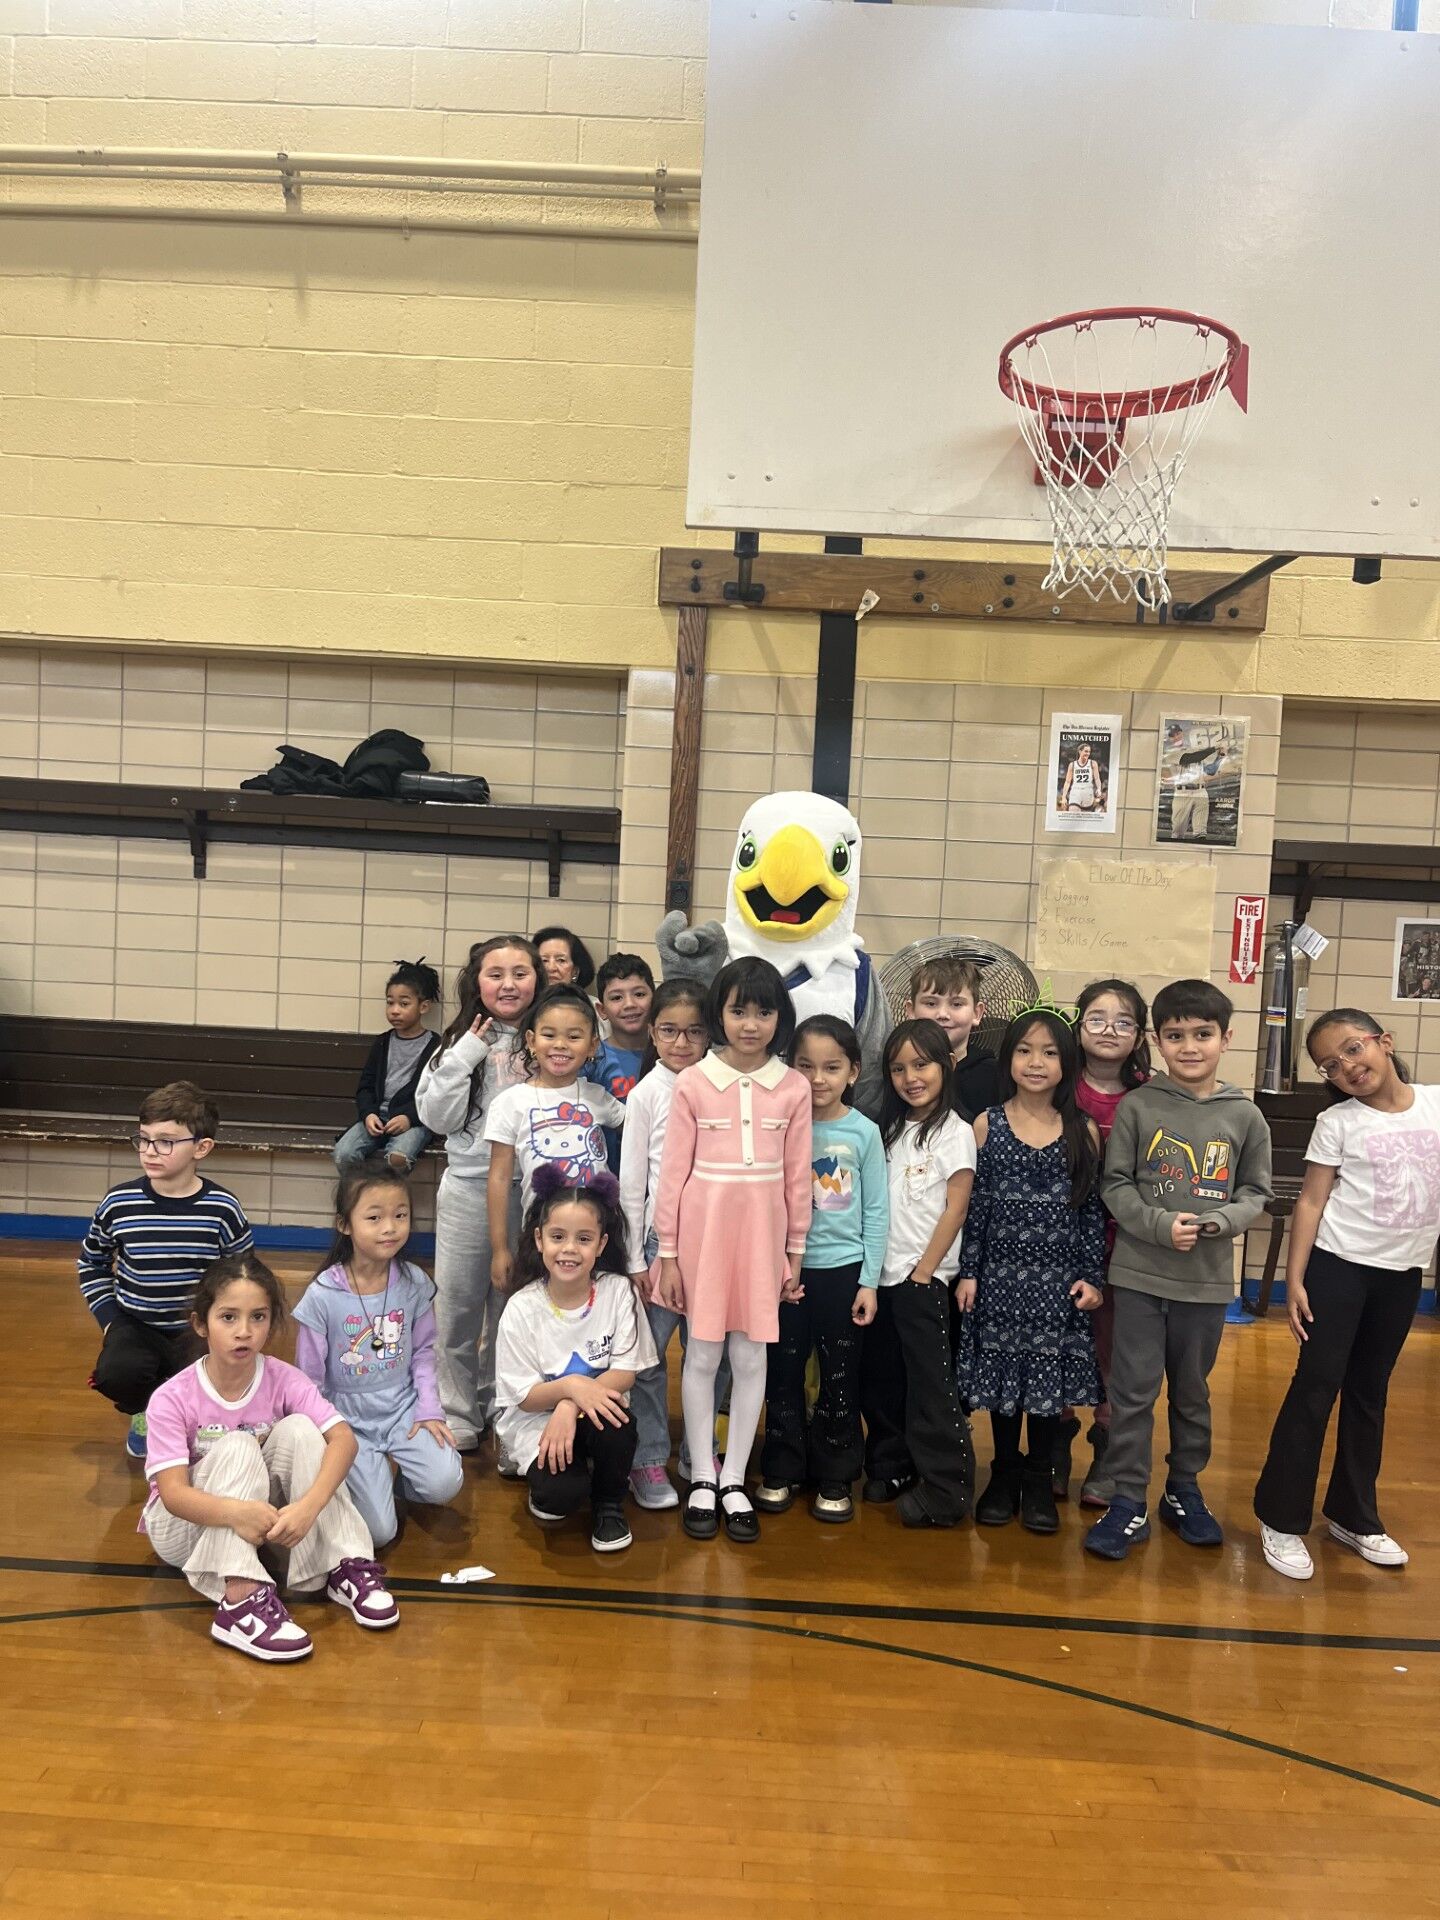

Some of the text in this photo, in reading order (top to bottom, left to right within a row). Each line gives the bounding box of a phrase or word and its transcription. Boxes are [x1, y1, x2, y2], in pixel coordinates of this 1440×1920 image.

[1062, 734, 1110, 742] UNMATCHED
[1076, 775, 1089, 783] 22
[1055, 885, 1089, 908] Jogging
[1056, 906, 1096, 925] Exercise
[1240, 904, 1260, 917] FIRE
[1242, 918, 1252, 976] EXTINGUISHER
[1158, 1147, 1178, 1157] DIG
[1160, 1163, 1184, 1180] DIG
[1152, 1179, 1175, 1198] DIG
